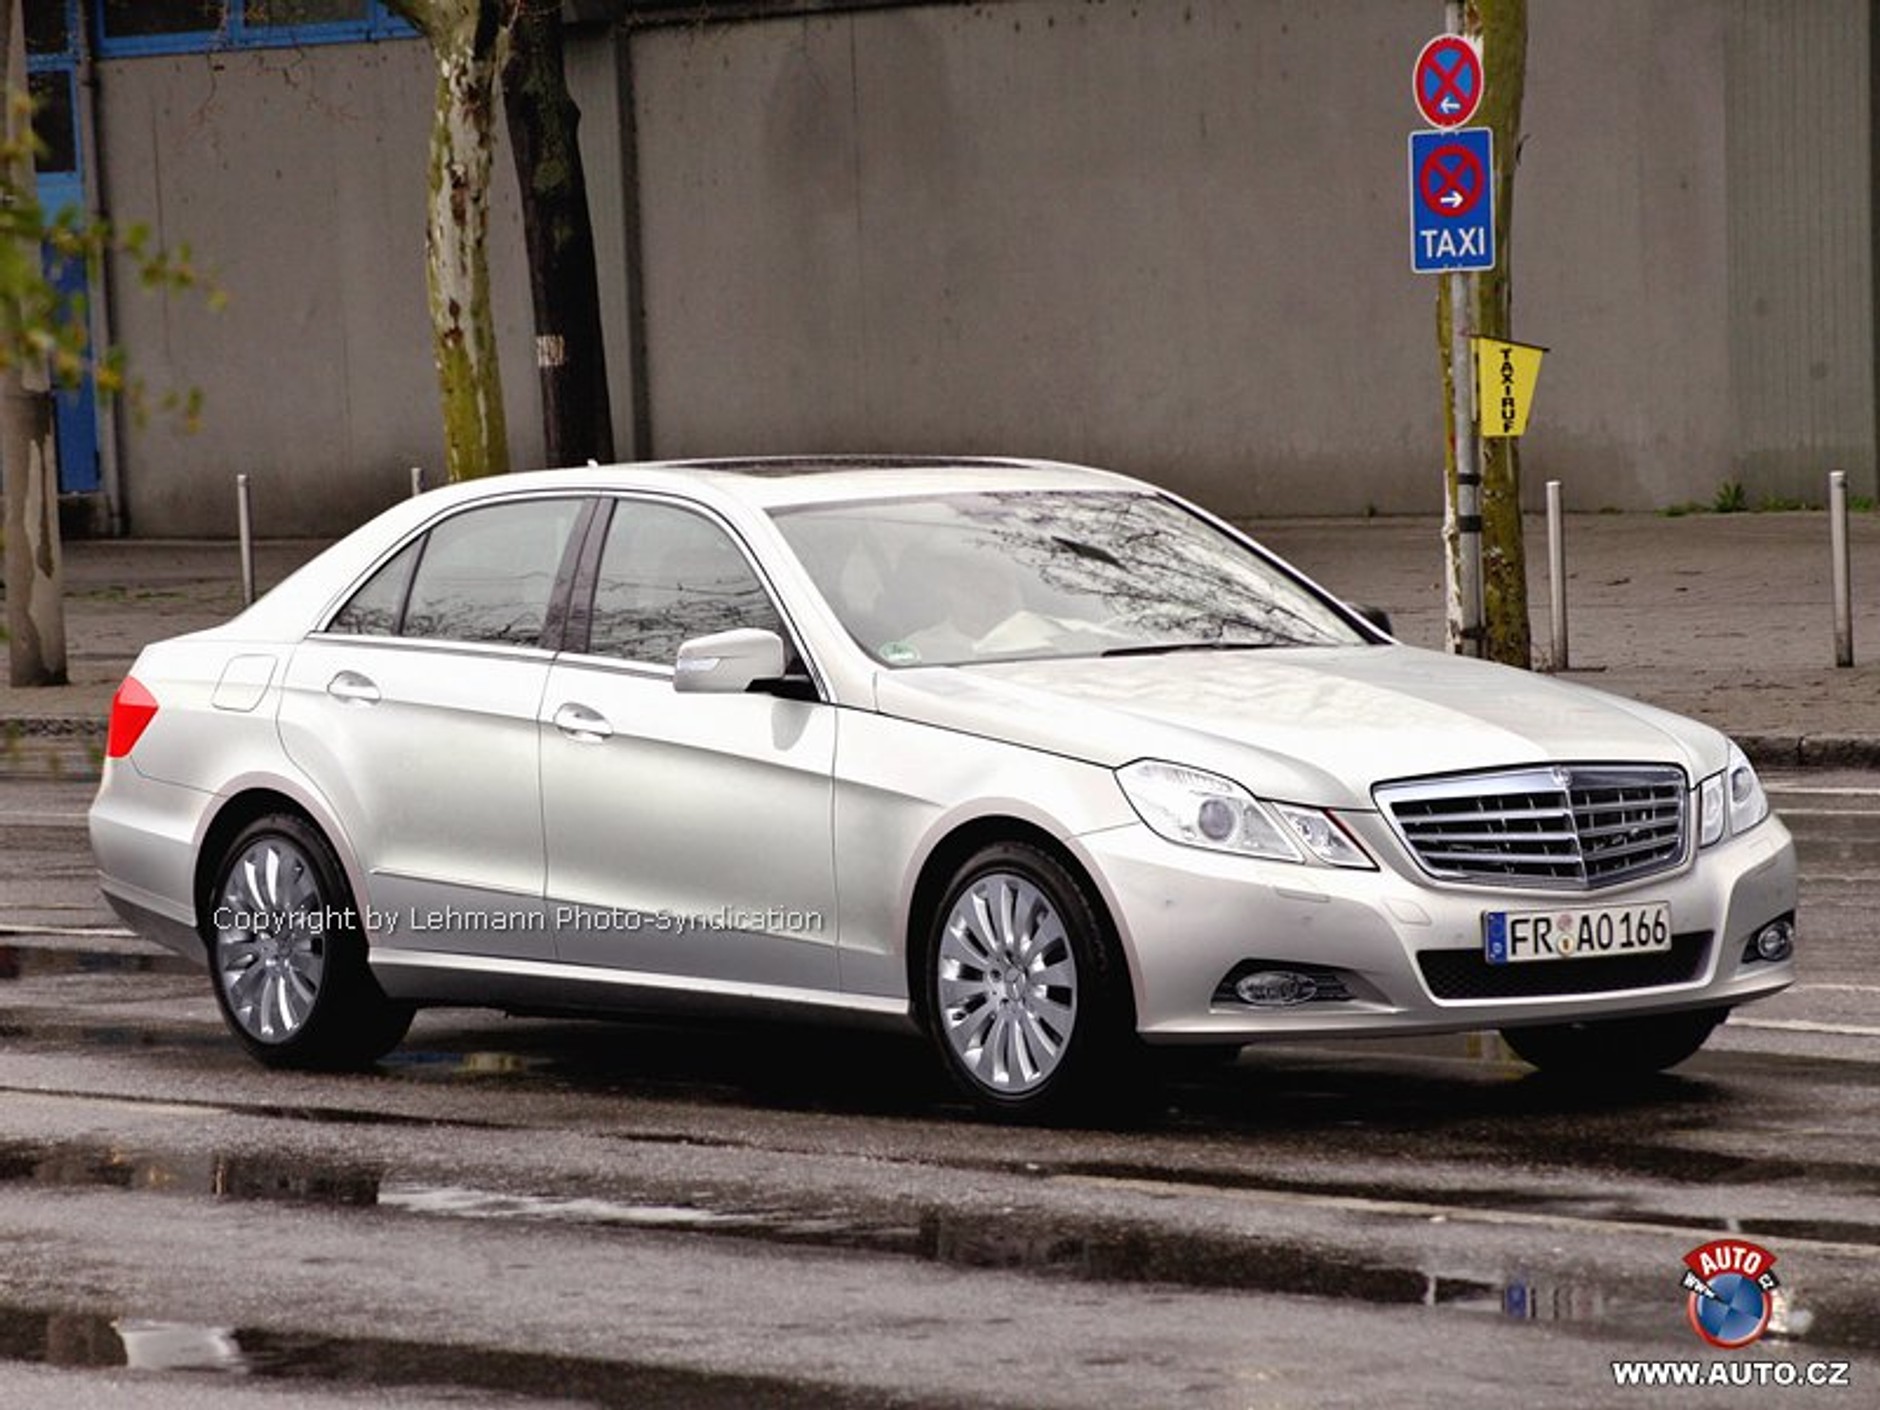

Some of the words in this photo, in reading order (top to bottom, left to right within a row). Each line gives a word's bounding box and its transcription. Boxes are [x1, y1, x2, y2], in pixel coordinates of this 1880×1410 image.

[1420, 227, 1485, 258] TAXI
[1500, 347, 1515, 433] TAXIRUF
[1510, 916, 1553, 955] FR
[1619, 909, 1667, 949] 166
